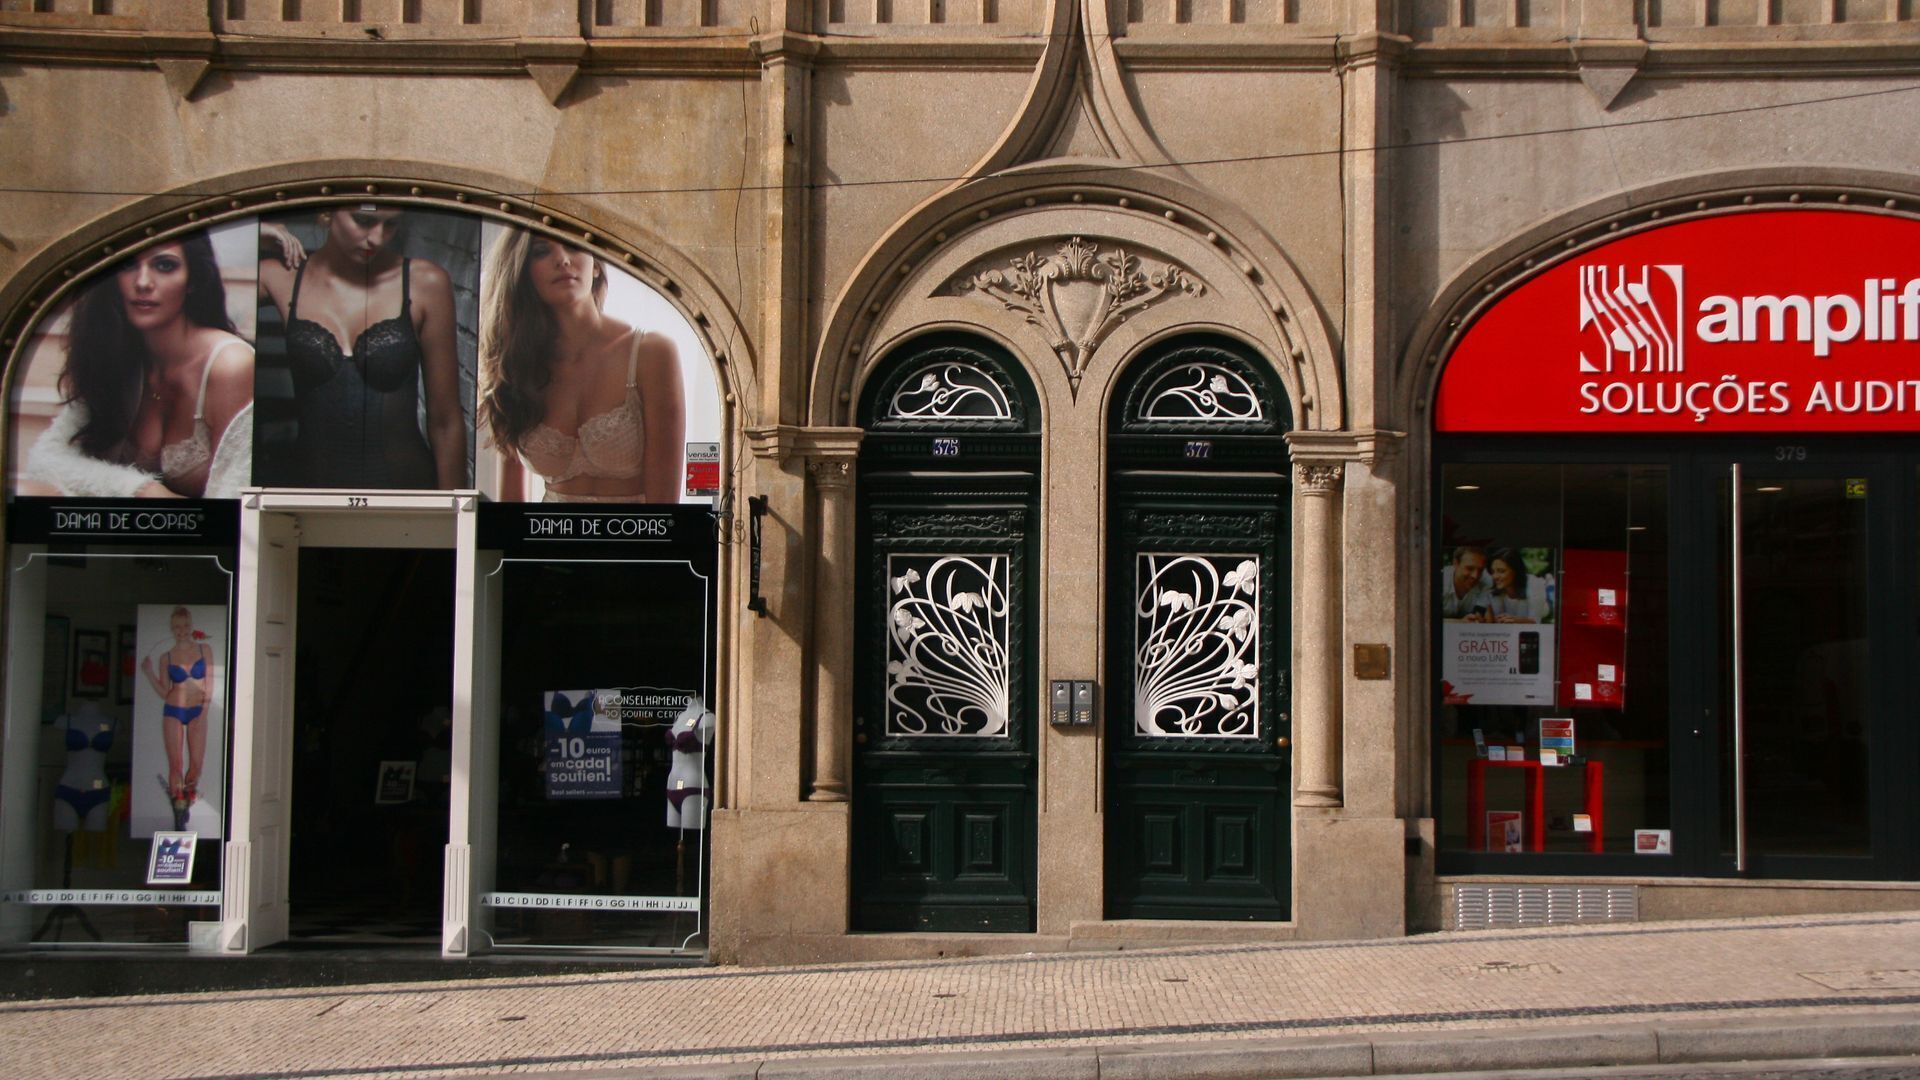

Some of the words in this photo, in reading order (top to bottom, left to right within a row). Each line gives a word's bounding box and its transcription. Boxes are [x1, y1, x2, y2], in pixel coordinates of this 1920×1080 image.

[1580, 374, 1790, 422] SOLUÇÕES
[934, 438, 960, 456] 375
[1185, 441, 1212, 458] 377
[1775, 446, 1807, 461] 379
[348, 497, 368, 508] 373
[56, 511, 101, 529] DAMA
[109, 512, 130, 530] DE
[529, 518, 573, 535] DAMA
[581, 518, 601, 535] DE
[1458, 639, 1509, 654] GRÁTIS
[597, 695, 693, 706] ACONSELHAMENTO
[605, 709, 619, 719] DO
[622, 710, 654, 719] SOUTIEN
[551, 737, 585, 759] -10
[586, 747, 611, 755] euros
[551, 760, 565, 769] em
[565, 757, 605, 770] cada
[136, 894, 152, 902] GG
[159, 894, 166, 902] H
[172, 894, 186, 902] HH
[192, 894, 198, 902] J
[204, 894, 215, 903] JJ
[481, 896, 488, 904] A
[495, 896, 501, 904] B
[535, 897, 549, 905] DD
[579, 898, 589, 906] FF
[595, 899, 603, 907] G
[610, 899, 625, 907] GG
[646, 900, 659, 908] HH
[665, 900, 671, 908] J
[677, 901, 688, 909] JJ
